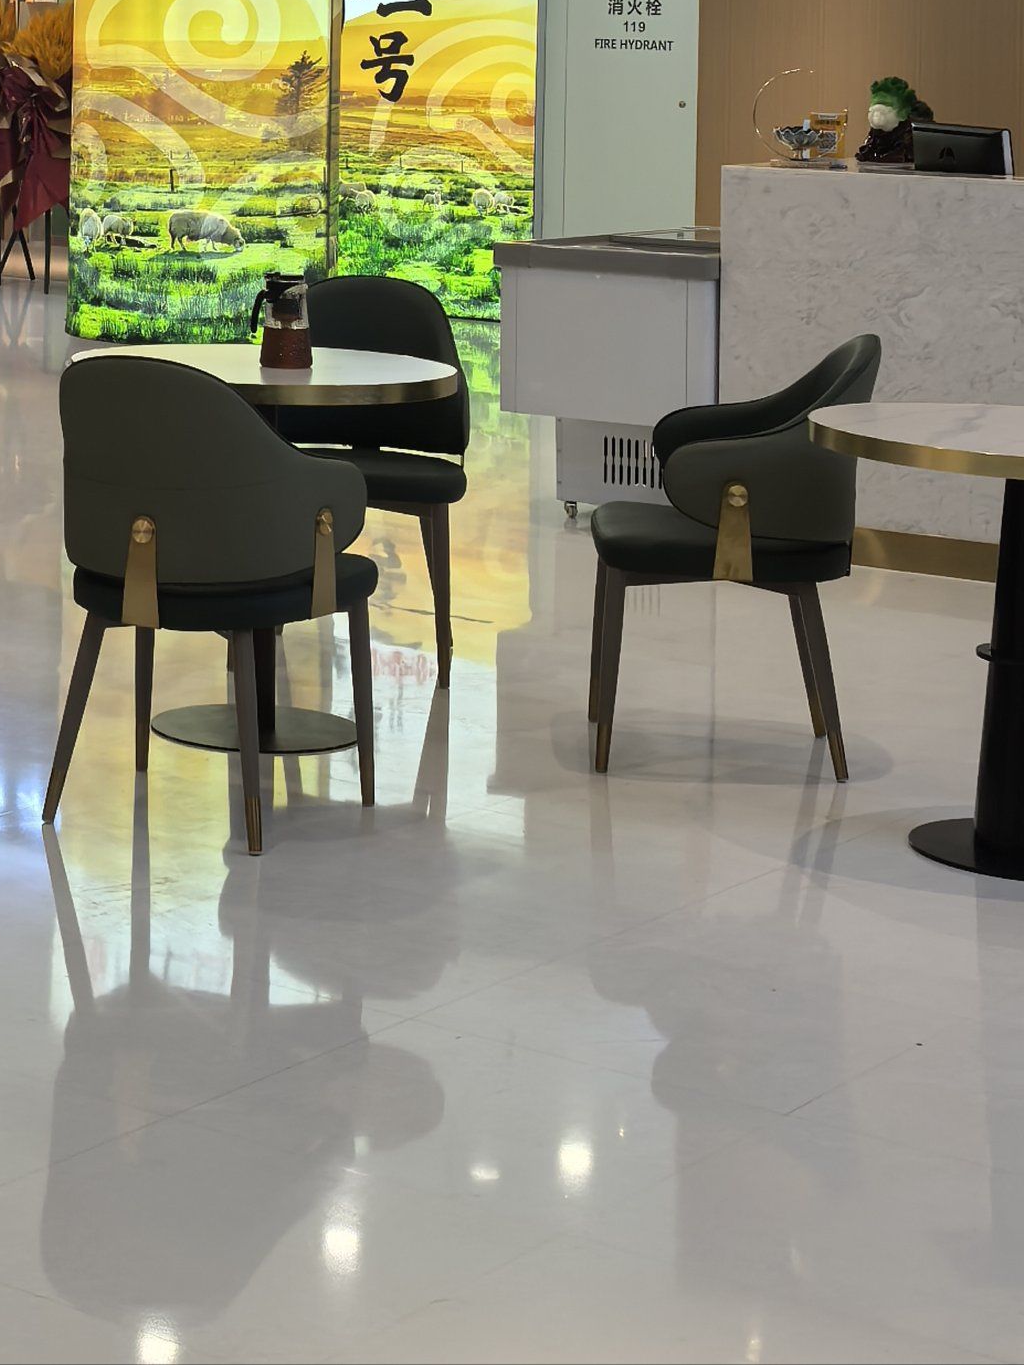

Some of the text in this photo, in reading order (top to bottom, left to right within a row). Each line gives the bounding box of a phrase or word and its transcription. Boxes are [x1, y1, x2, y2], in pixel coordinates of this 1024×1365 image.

[623, 20, 646, 33] 119
[594, 38, 674, 51] FIRE HYDRANT
